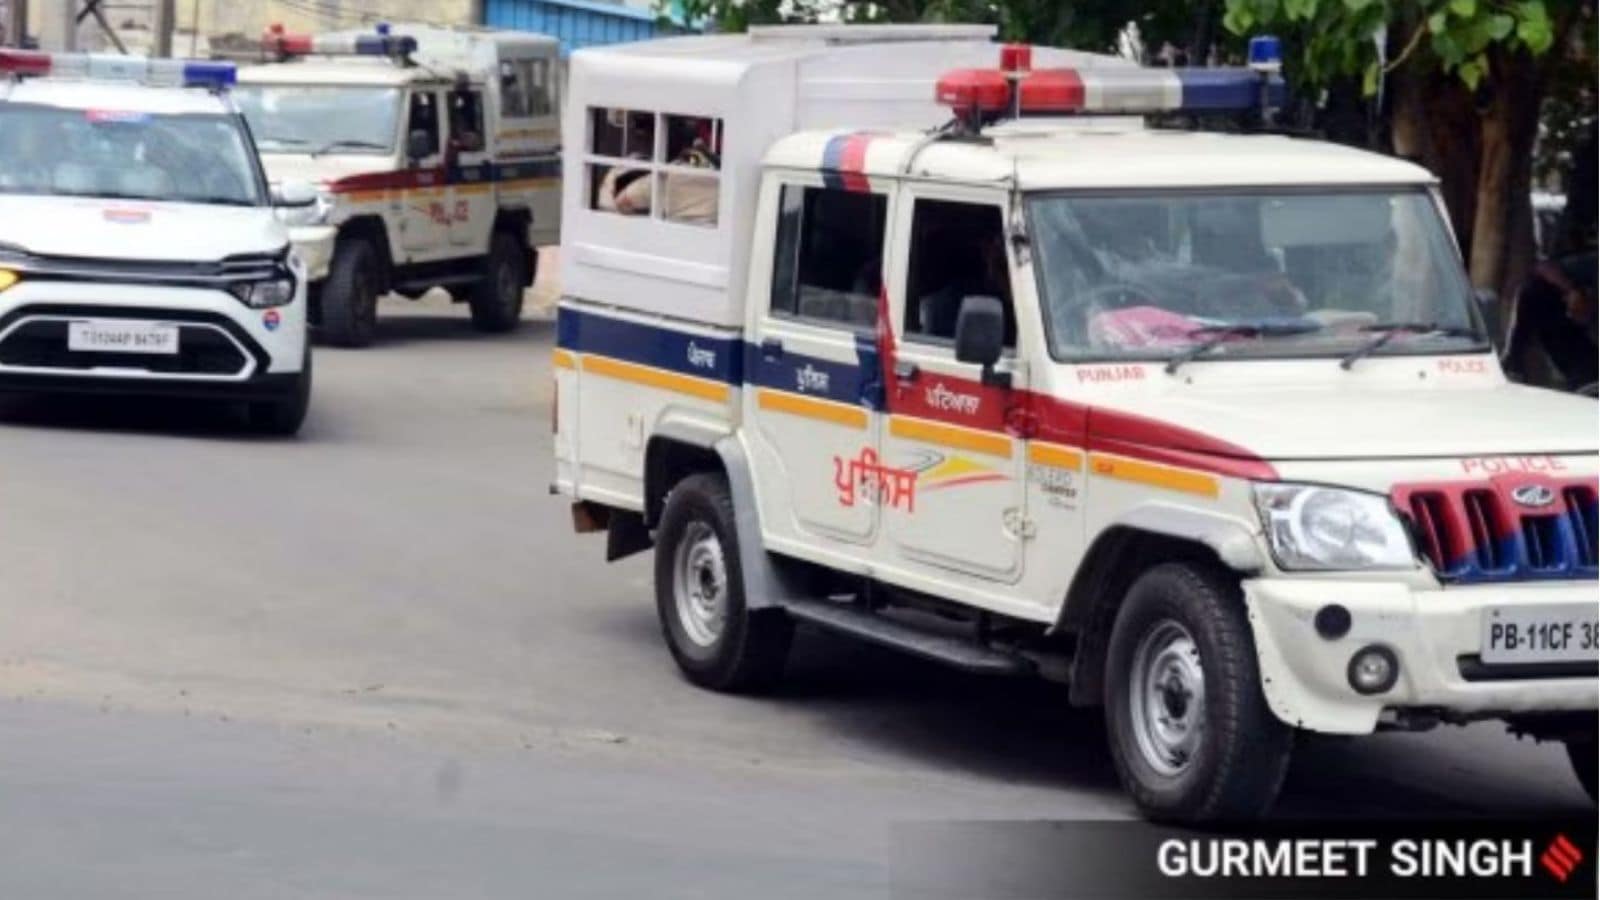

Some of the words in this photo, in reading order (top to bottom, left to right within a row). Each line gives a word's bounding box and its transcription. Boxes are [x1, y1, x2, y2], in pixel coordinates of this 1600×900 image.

[1076, 365, 1145, 383] PUNJAB
[1438, 359, 1486, 374] POLICE
[1461, 455, 1567, 474] POLICE
[1490, 622, 1573, 650] PB-11CF
